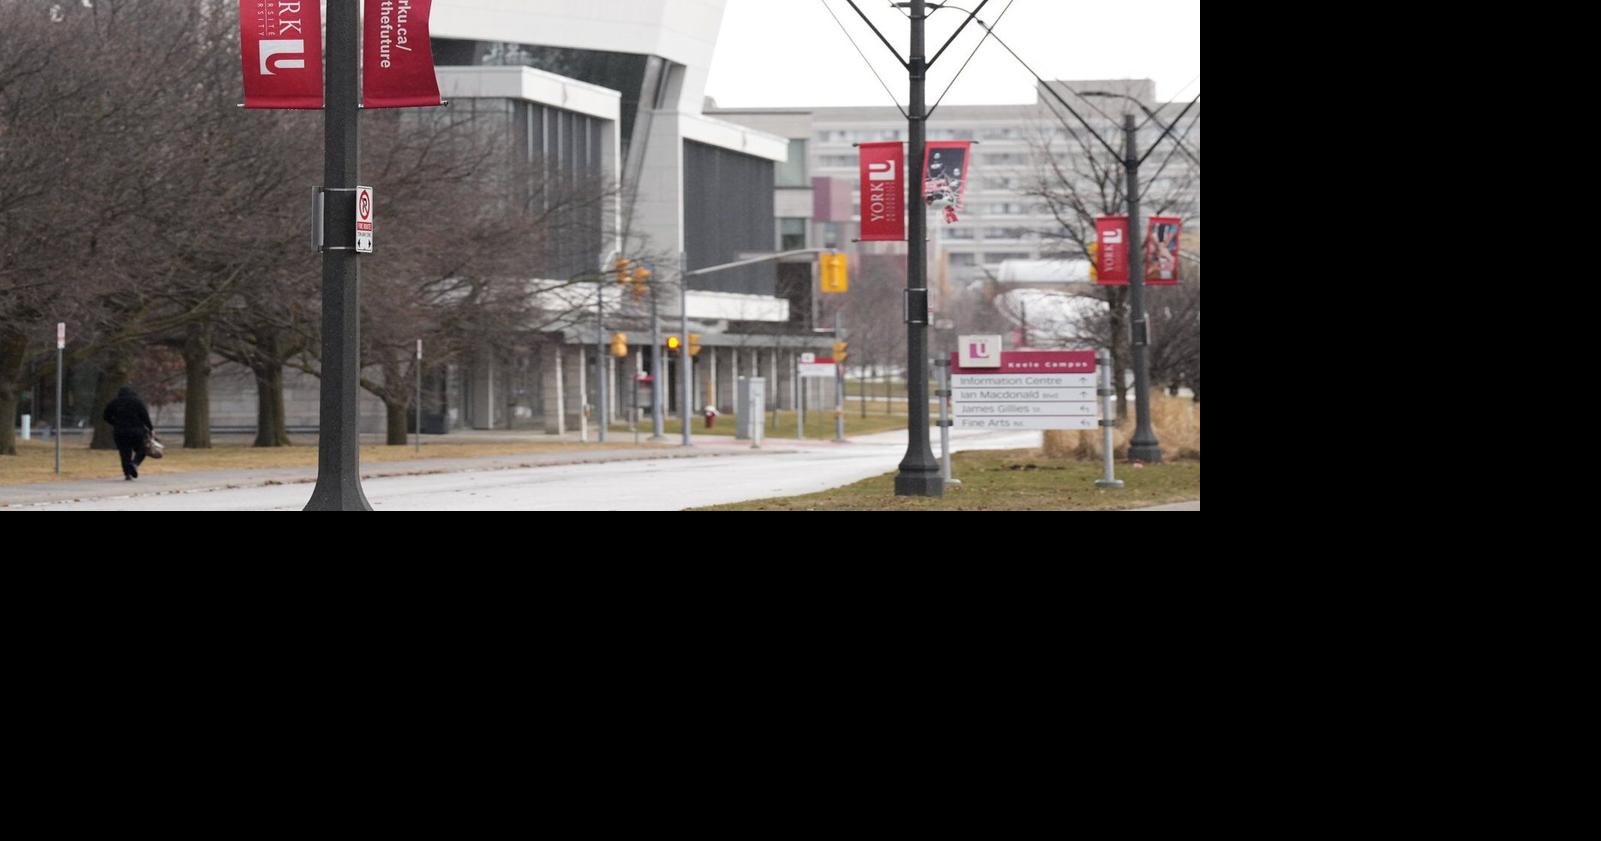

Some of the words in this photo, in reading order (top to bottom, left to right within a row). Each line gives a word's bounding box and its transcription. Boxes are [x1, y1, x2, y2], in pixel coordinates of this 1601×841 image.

[870, 183, 885, 222] YORK
[960, 376, 1022, 385] Information
[1024, 376, 1063, 385] Centre
[960, 390, 977, 399] Ian
[980, 390, 1040, 399] Macdonald
[962, 404, 995, 413] James
[962, 418, 986, 427] Fine
[988, 418, 1011, 427] Arts
